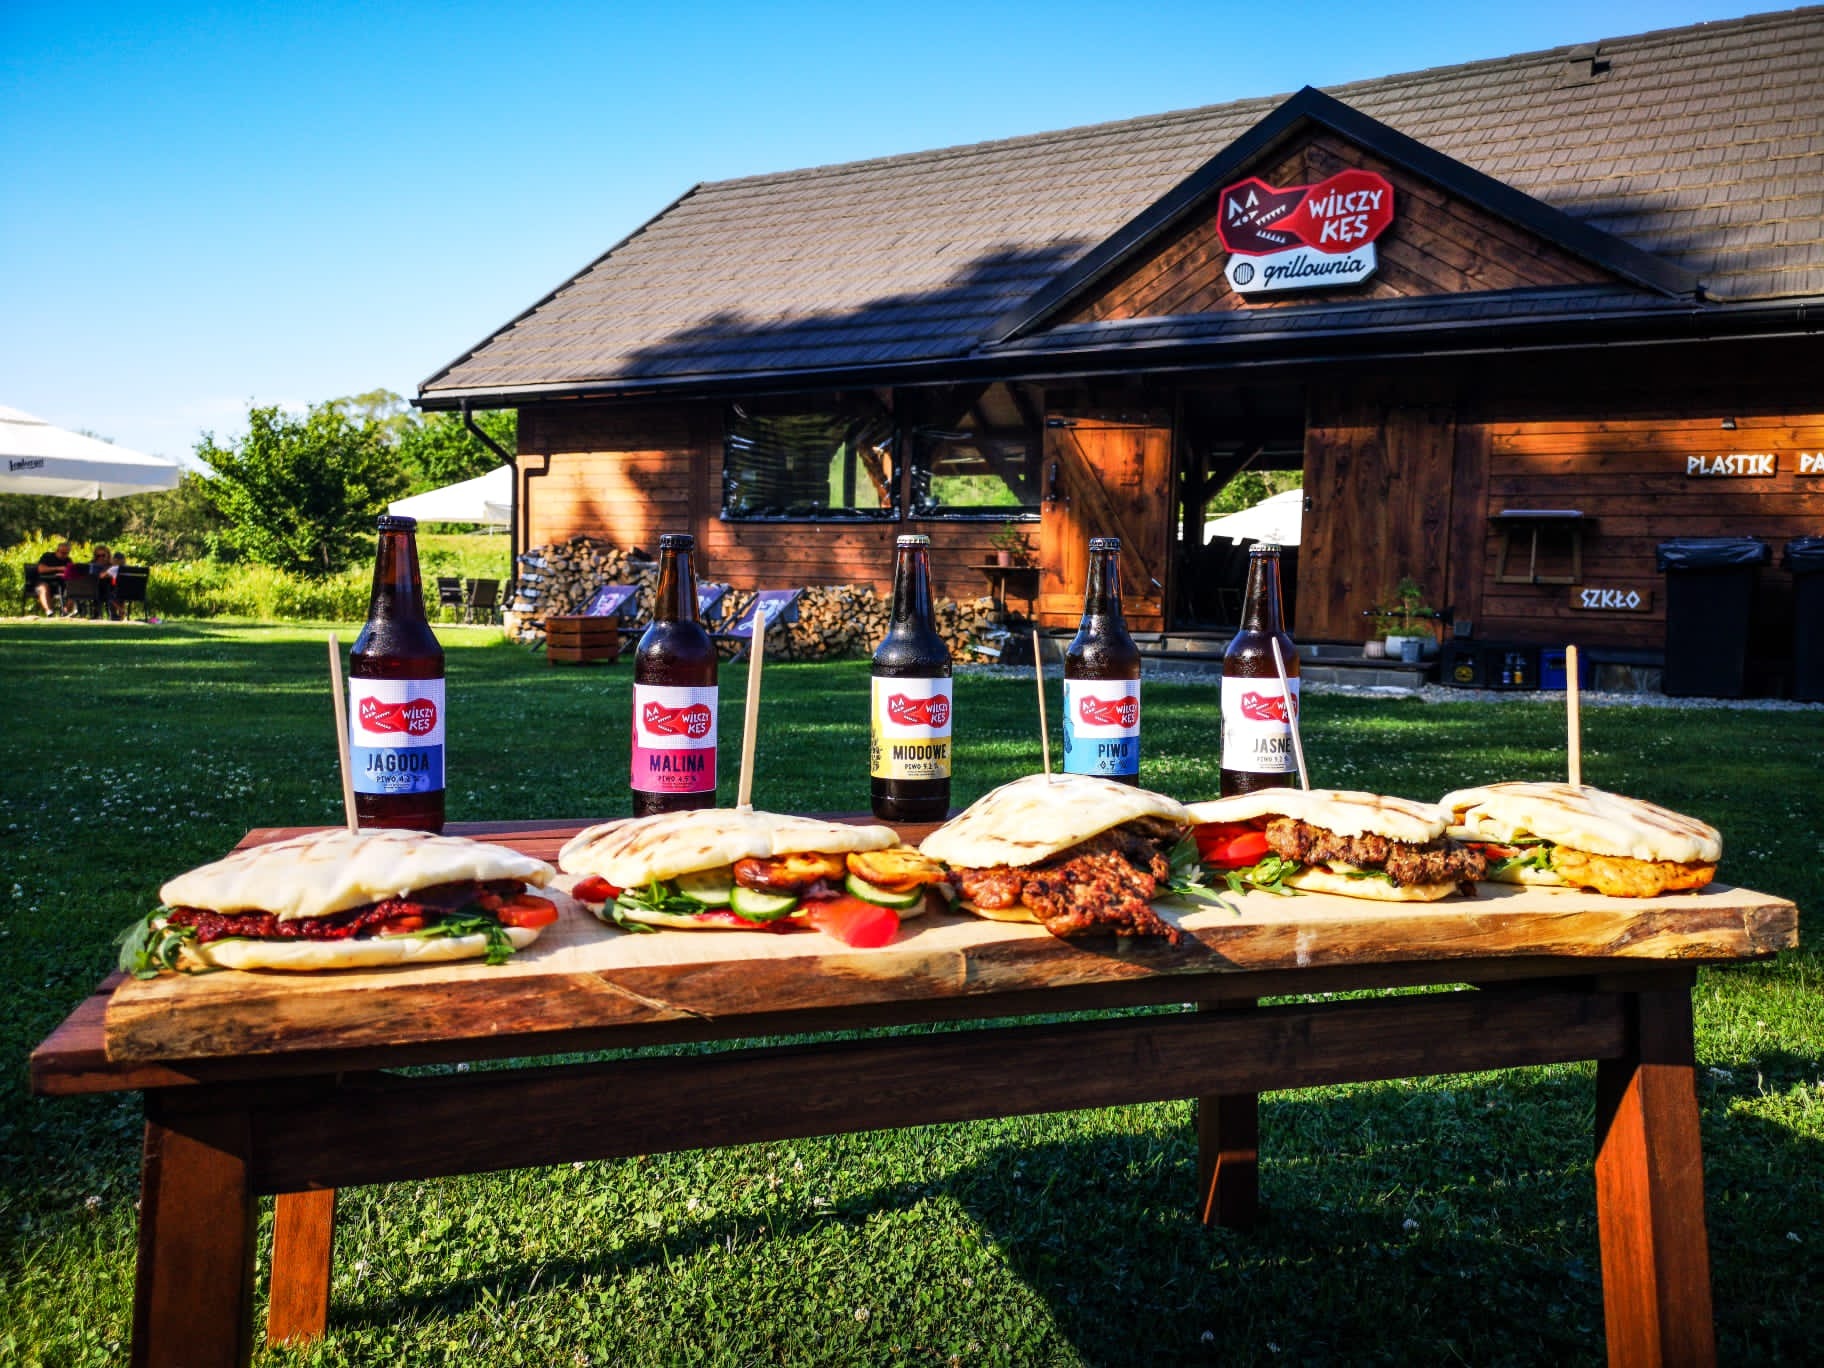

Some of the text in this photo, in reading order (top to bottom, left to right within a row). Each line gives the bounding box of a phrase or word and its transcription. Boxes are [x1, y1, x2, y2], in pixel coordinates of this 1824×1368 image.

[1320, 215, 1368, 243] KĘS
[1264, 255, 1365, 287] grillownia
[1687, 454, 1775, 474] PLASTIK
[1580, 588, 1641, 609] SZKŁO
[892, 743, 947, 761] MIODOWE
[1098, 743, 1129, 758] PIWO
[1253, 738, 1291, 753] JASNE
[367, 754, 429, 771] JAGODA
[649, 754, 705, 772] MALINA
